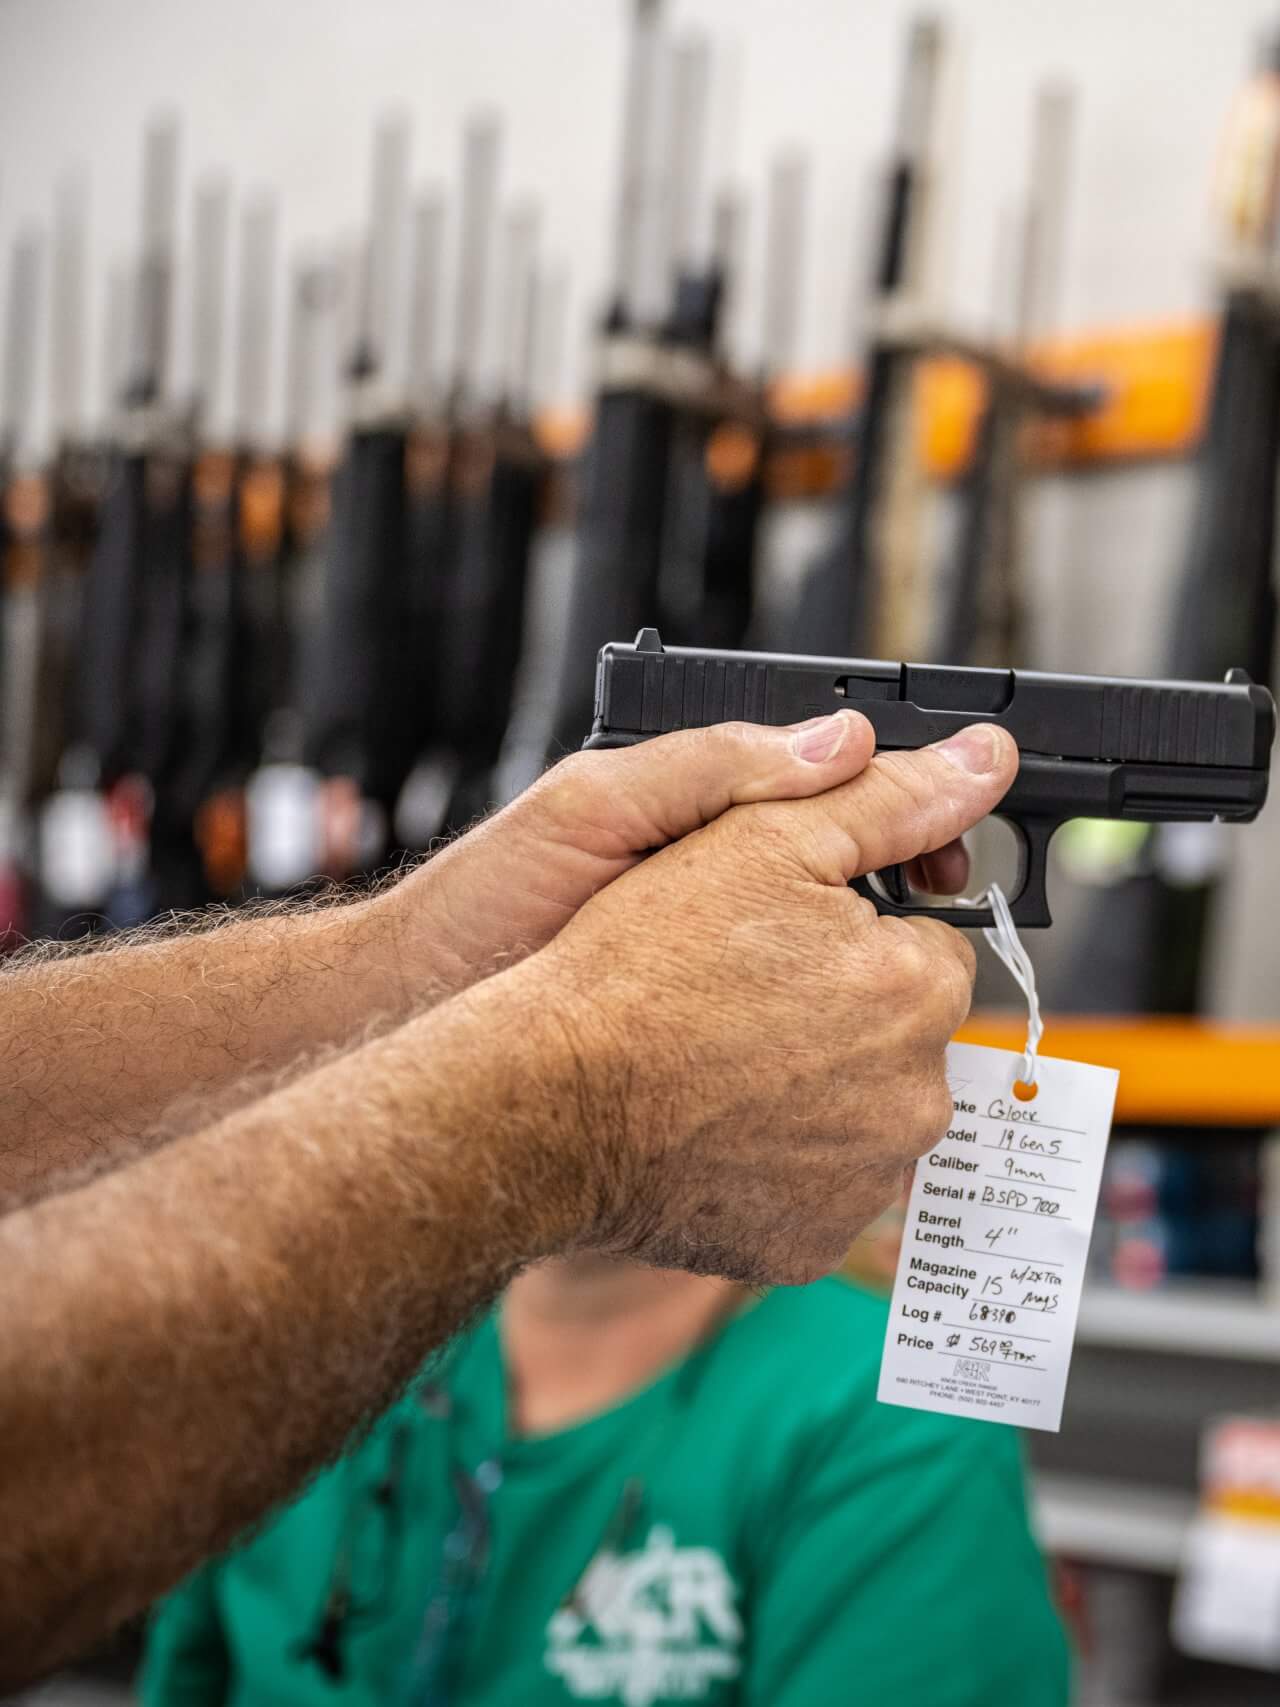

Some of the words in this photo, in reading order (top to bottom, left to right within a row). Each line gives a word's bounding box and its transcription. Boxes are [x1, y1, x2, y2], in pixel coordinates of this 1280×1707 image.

[952, 1101, 977, 1114] ake
[988, 1099, 1040, 1122] Glock
[947, 1130, 977, 1144] odel
[999, 1128, 1014, 1150] 19
[928, 1154, 980, 1173] Caliber
[1004, 1158, 1047, 1182] 9mm
[923, 1182, 964, 1200] Serial
[967, 1190, 977, 1201] #
[918, 1210, 961, 1229] Barrel
[915, 1229, 965, 1249] Length
[909, 1257, 977, 1280] Magazine
[907, 1276, 969, 1300] Capacity
[981, 1275, 1003, 1296] 15
[901, 1304, 929, 1322] Log
[932, 1309, 942, 1321] #
[897, 1333, 934, 1350] Price
[940, 1384, 958, 1392] LANE
[965, 1389, 985, 1397] WEST
